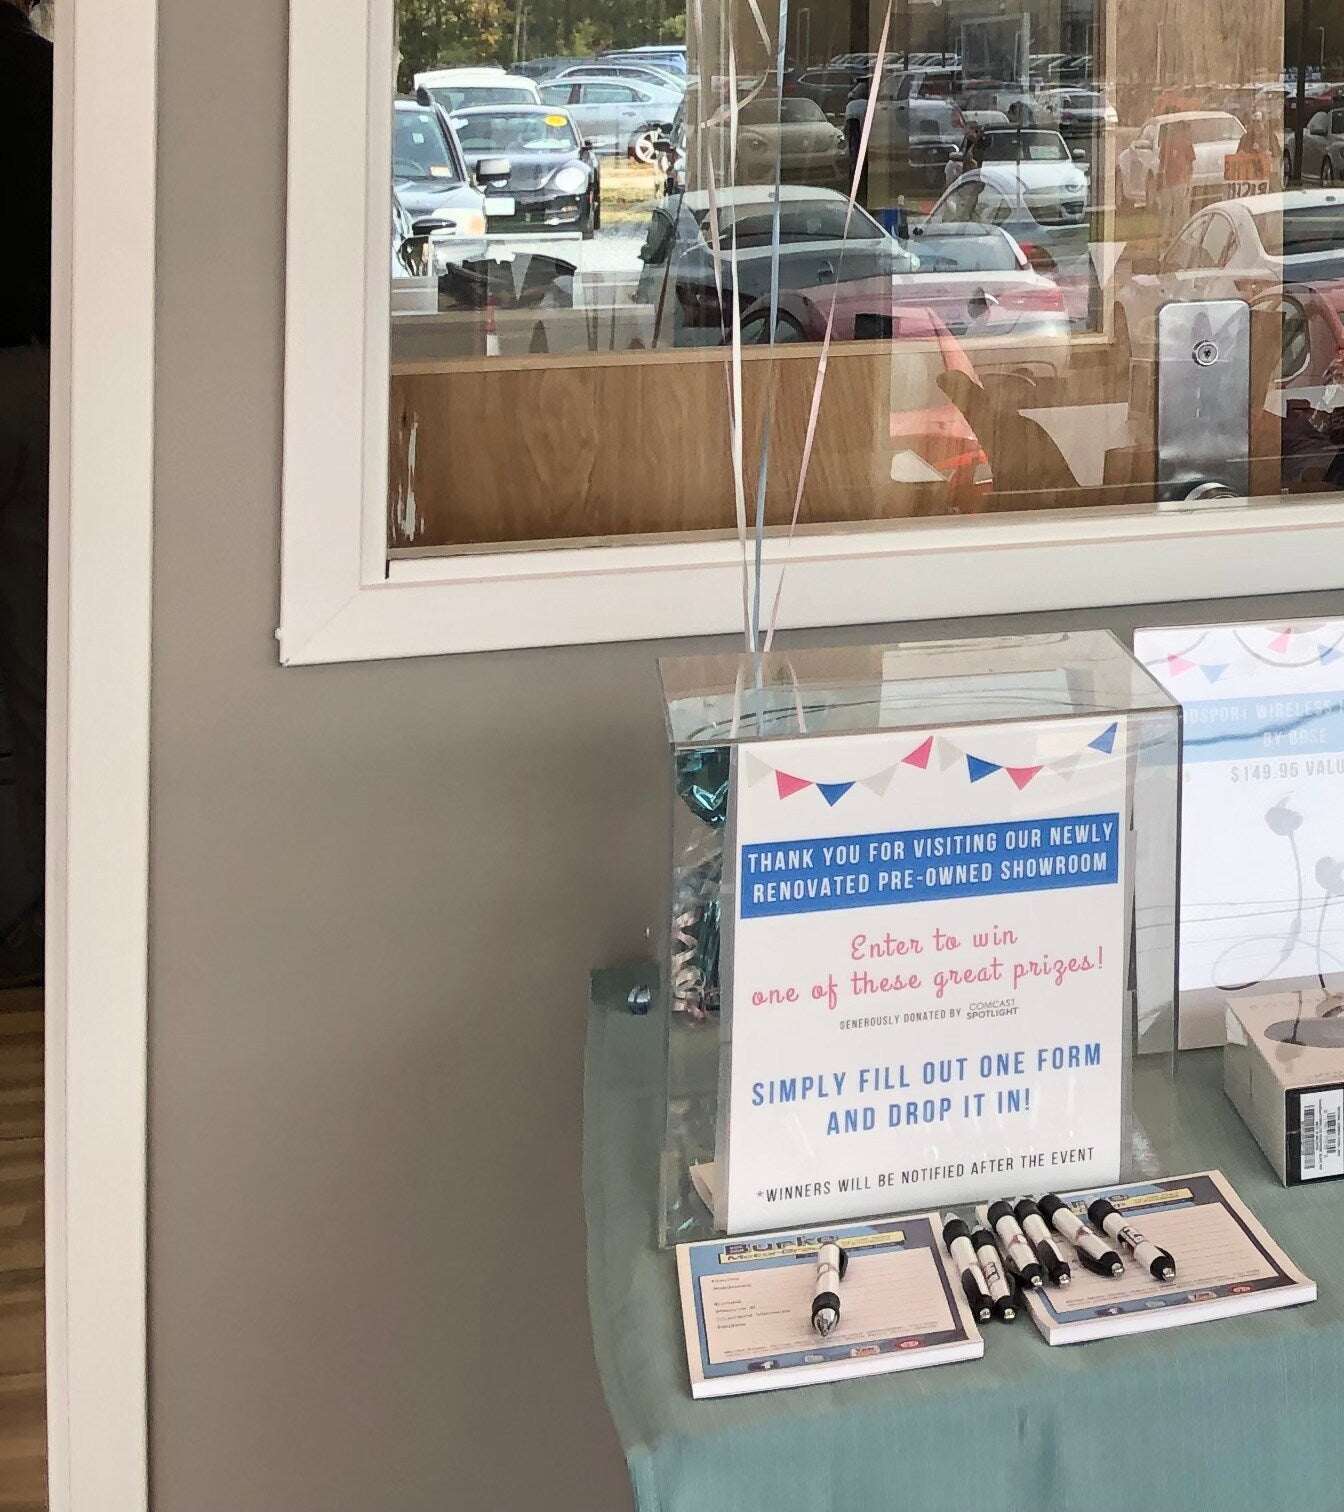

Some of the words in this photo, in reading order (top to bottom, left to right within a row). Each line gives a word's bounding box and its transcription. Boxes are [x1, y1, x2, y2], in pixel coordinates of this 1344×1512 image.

[1255, 699, 1332, 720] WIRELESS
[1230, 761, 1299, 783] $149.95
[747, 848, 814, 875] THANK
[822, 844, 861, 867] YOU
[868, 840, 905, 863] FOR
[912, 832, 998, 859] VISITING
[1004, 828, 1042, 851] OUR
[1049, 821, 1114, 847] NEWLY
[752, 872, 870, 904] RENOVATED
[877, 861, 993, 892] PRE-OWNED
[1000, 851, 1108, 881] SHOWROOM
[850, 933, 924, 961] Enter
[932, 927, 961, 953] to
[972, 924, 1019, 948] win
[751, 988, 800, 1007] one
[810, 973, 839, 1011] of
[850, 970, 922, 997] these
[933, 956, 1004, 999] great
[1012, 945, 1105, 990] prizes!
[839, 1014, 900, 1031] GENEROUSLY
[903, 1009, 946, 1023] DONATED
[949, 1007, 963, 1019] BY
[966, 1006, 1020, 1021] SPOTLIGHT
[968, 998, 1017, 1012] COMCAST
[751, 1071, 847, 1108] SIMPLY
[858, 1064, 911, 1093] FILL
[922, 1057, 969, 1086] OUT
[979, 1050, 1026, 1079] ONE
[1037, 1042, 1102, 1072] FORM
[826, 1106, 876, 1136] AND
[888, 1097, 952, 1129] DROP
[963, 1092, 986, 1119] IT
[997, 1087, 1031, 1115] IN!
[838, 1175, 871, 1194] WILL
[877, 1172, 896, 1188] BE
[900, 1162, 965, 1185] NOTIFIED
[970, 1156, 1015, 1176] AFTER
[1020, 1152, 1046, 1170] THE
[1050, 1146, 1096, 1166] EVENT
